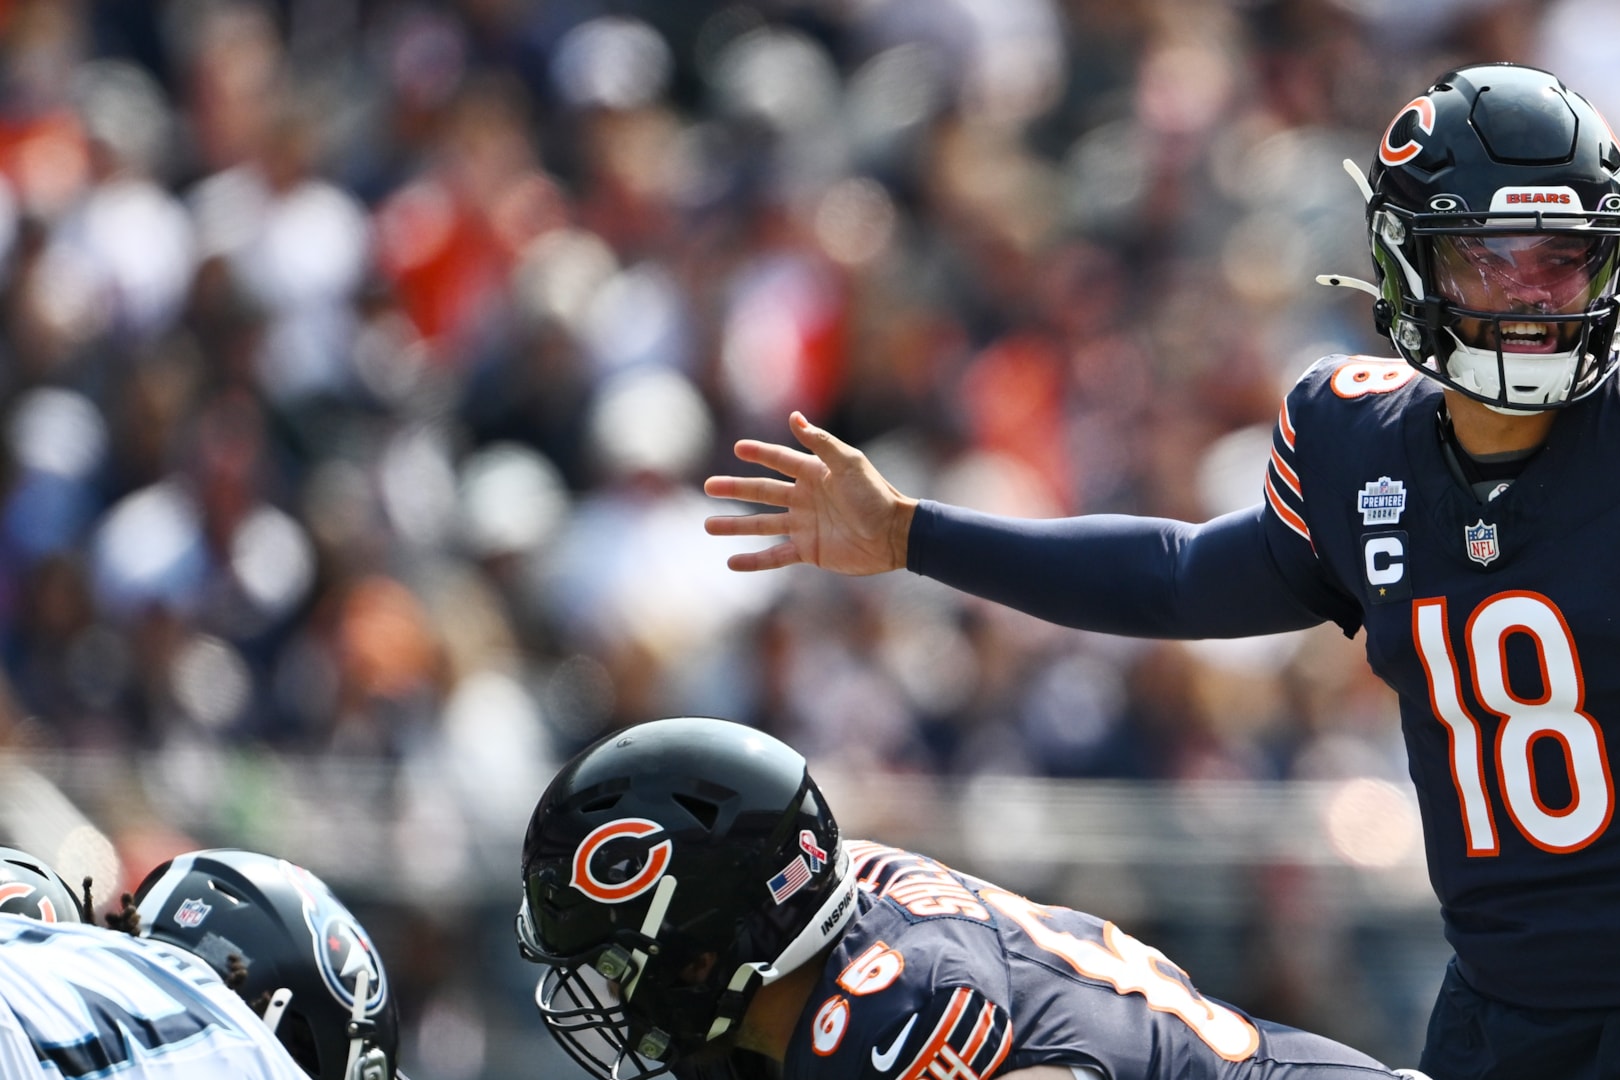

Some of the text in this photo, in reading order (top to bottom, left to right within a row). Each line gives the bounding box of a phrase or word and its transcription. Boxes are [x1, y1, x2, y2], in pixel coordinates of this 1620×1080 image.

[1379, 96, 1436, 167] C
[1506, 192, 1571, 205] BEARS
[1330, 355, 1425, 399] 8
[1372, 509, 1393, 519] 2024
[1365, 537, 1404, 585] C
[1471, 541, 1494, 558] NFL
[1412, 589, 1616, 858] 18
[569, 818, 673, 904] C
[811, 940, 905, 1057] 65
